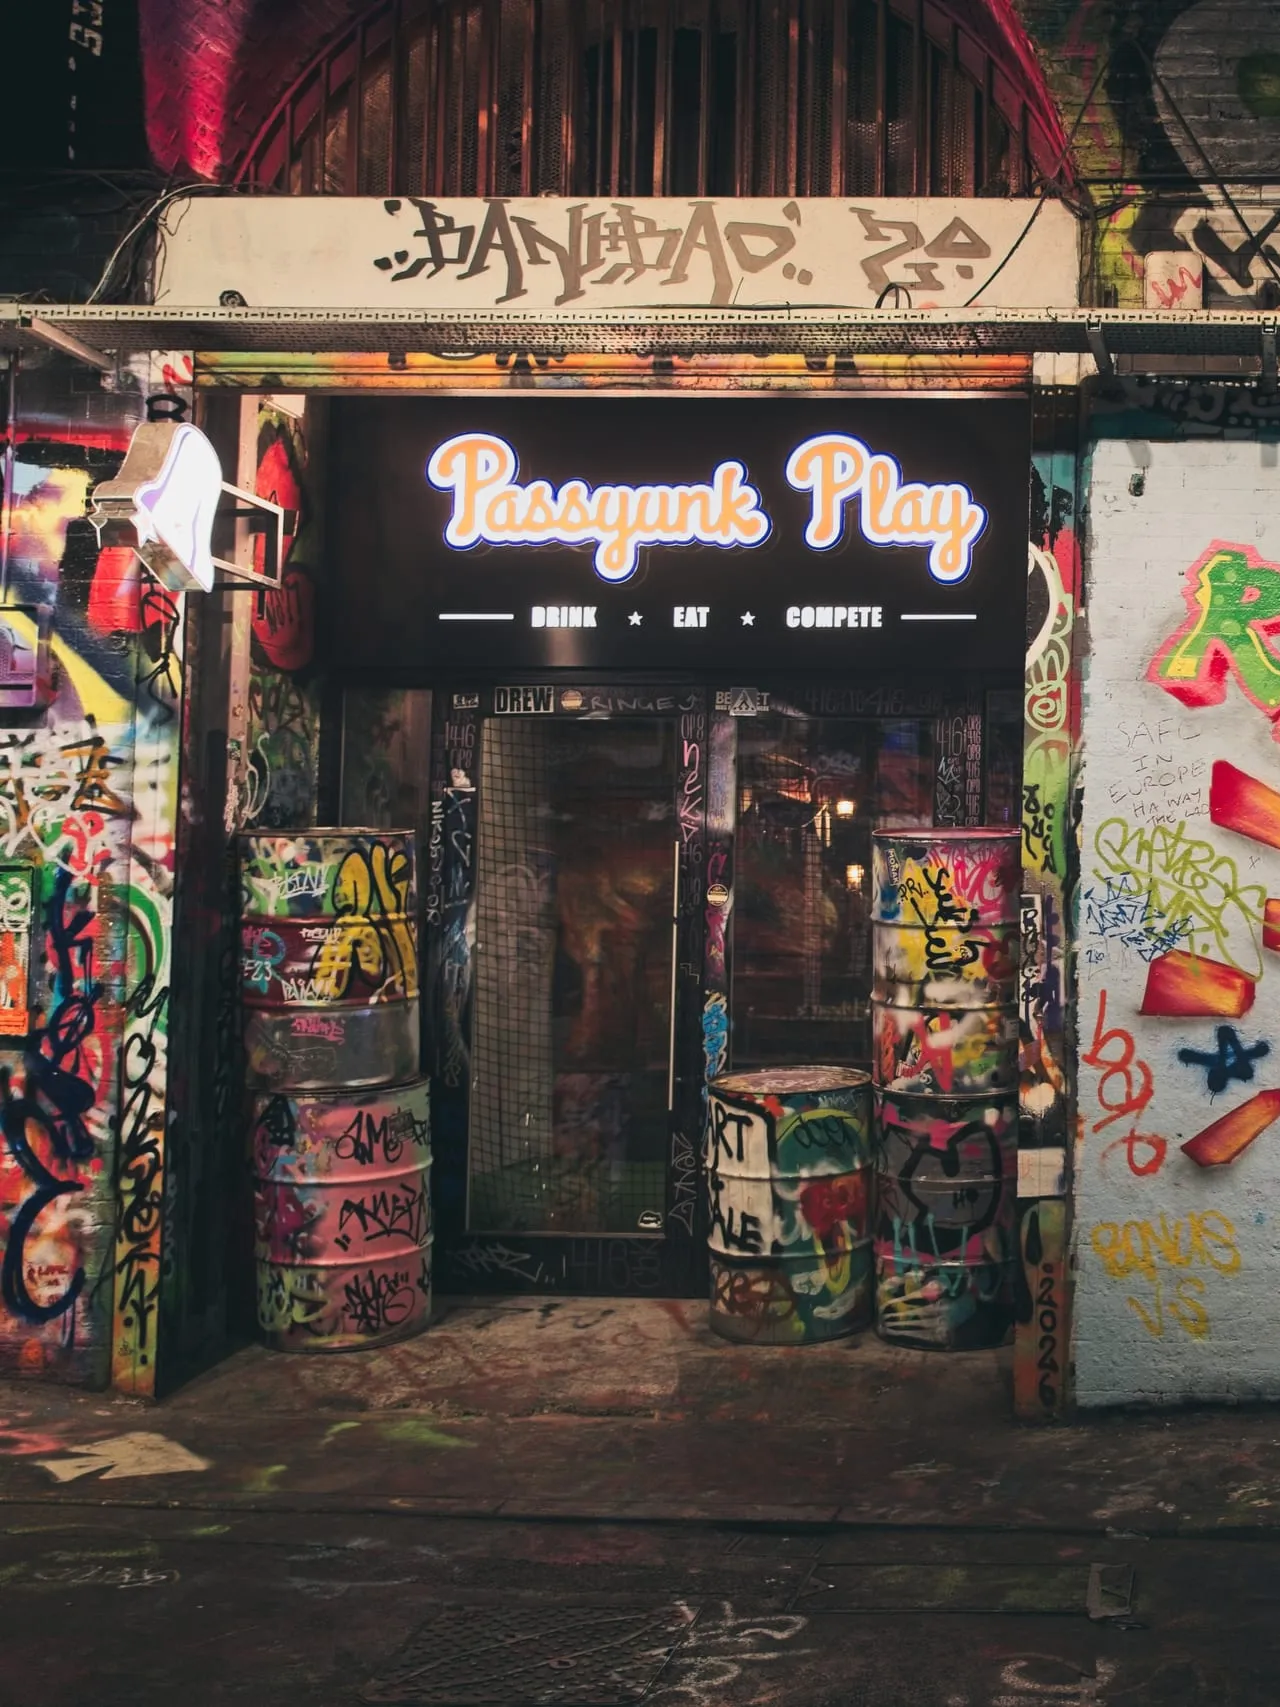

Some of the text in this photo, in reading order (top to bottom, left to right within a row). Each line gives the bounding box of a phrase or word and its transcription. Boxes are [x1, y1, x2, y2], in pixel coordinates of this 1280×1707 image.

[428, 431, 987, 583] Passyunk Play
[531, 607, 883, 628] DRINK EAT COMPETE
[496, 687, 554, 712] DREW
[1132, 751, 1173, 772] IN
[1107, 757, 1206, 804] EUROPE
[1090, 1209, 1242, 1282] BONUS
